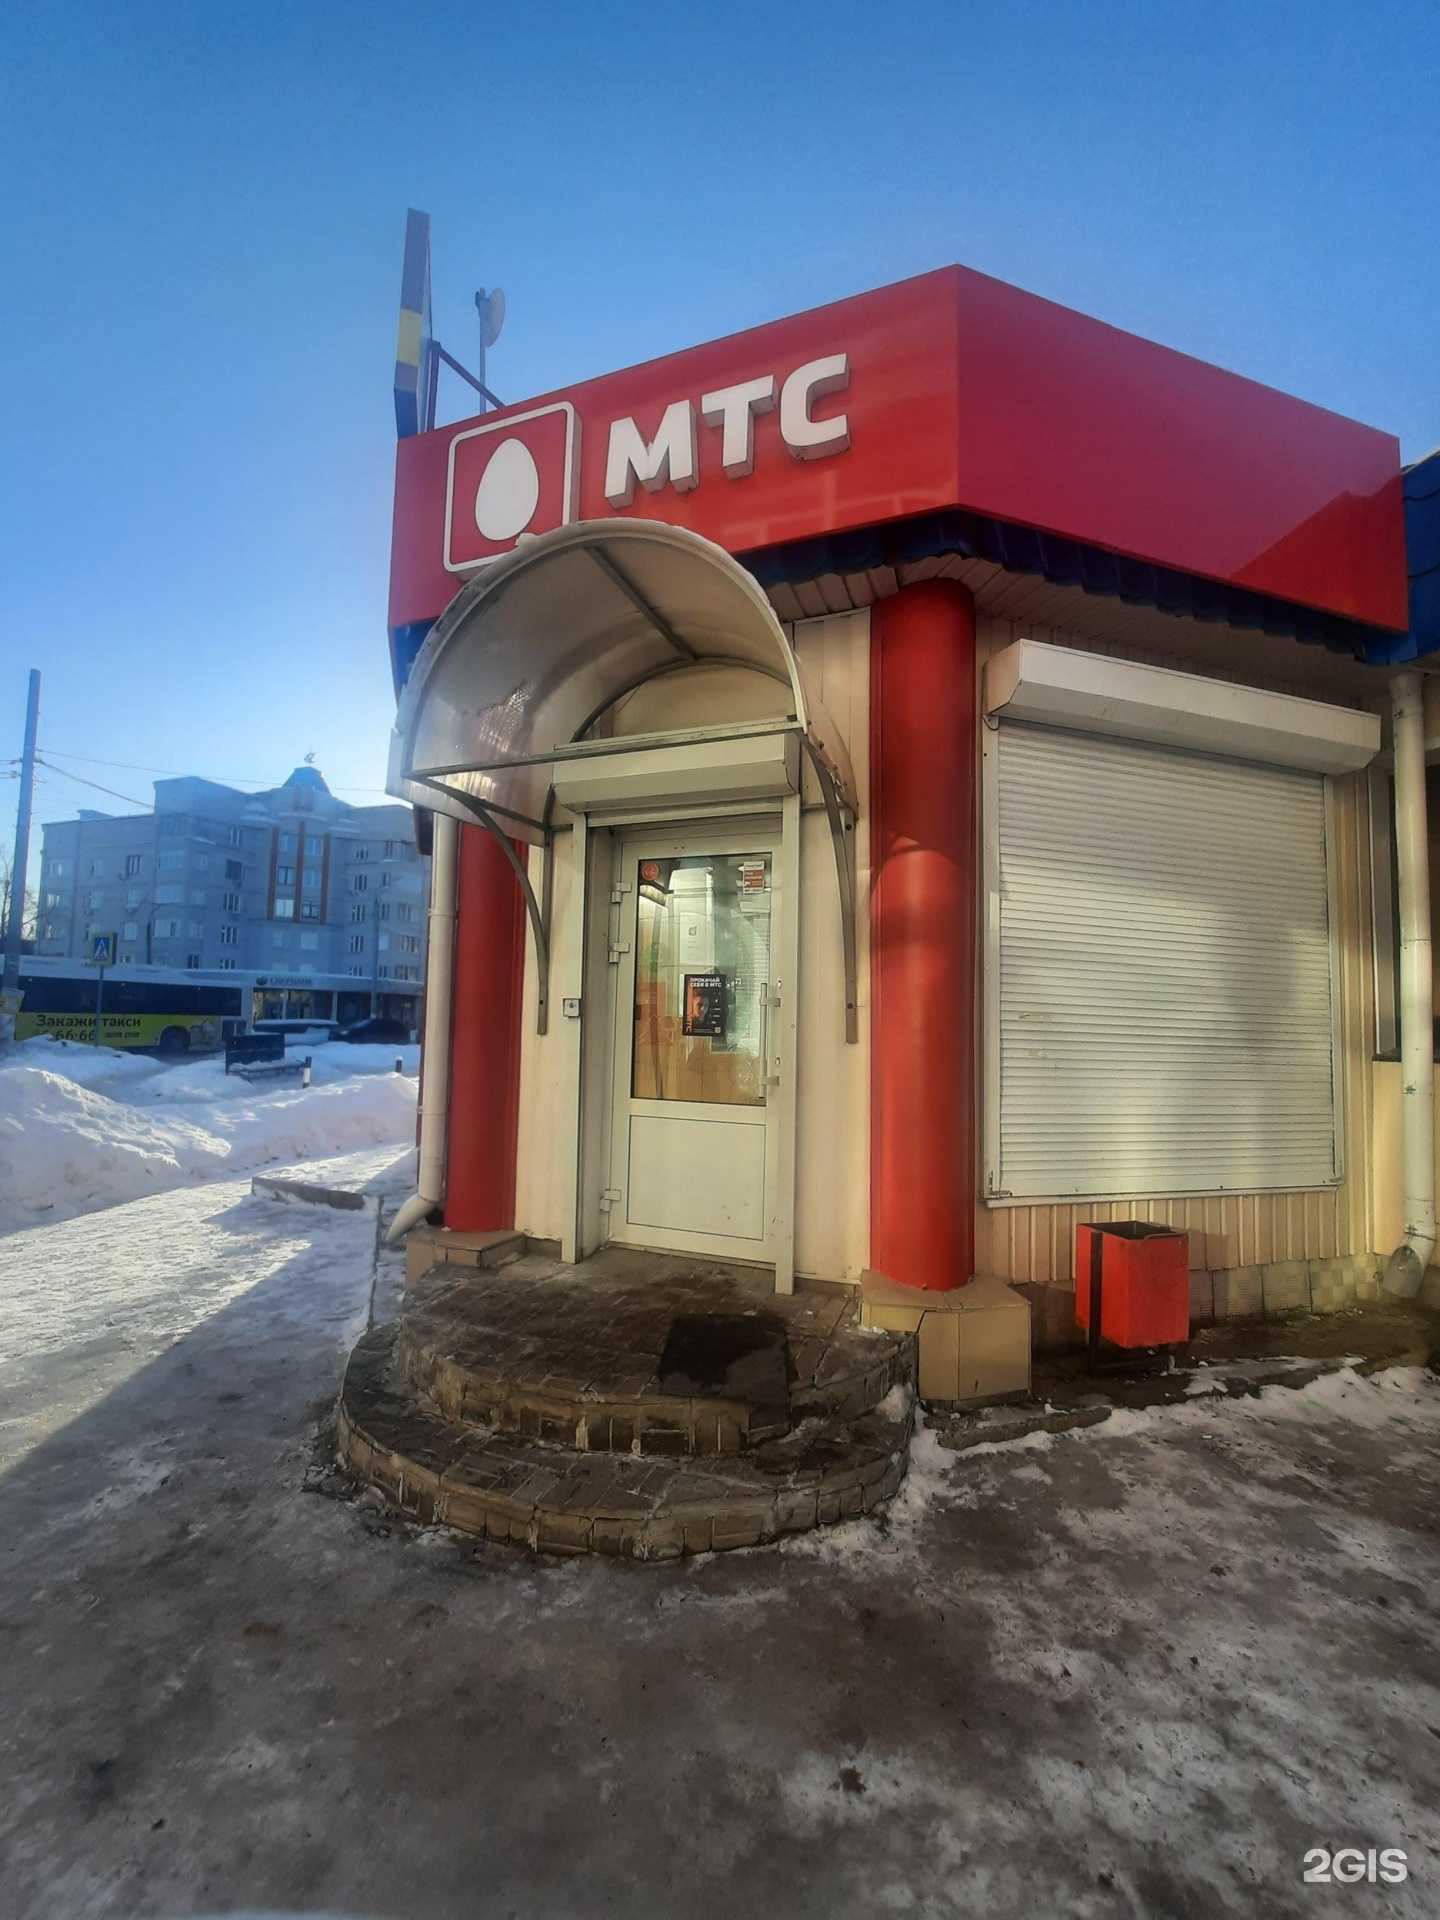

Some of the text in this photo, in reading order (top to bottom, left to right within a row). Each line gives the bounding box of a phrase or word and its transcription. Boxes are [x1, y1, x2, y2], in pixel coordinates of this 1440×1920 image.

[604, 353, 849, 505] МТС
[36, 1014, 141, 1027] Закажи такси
